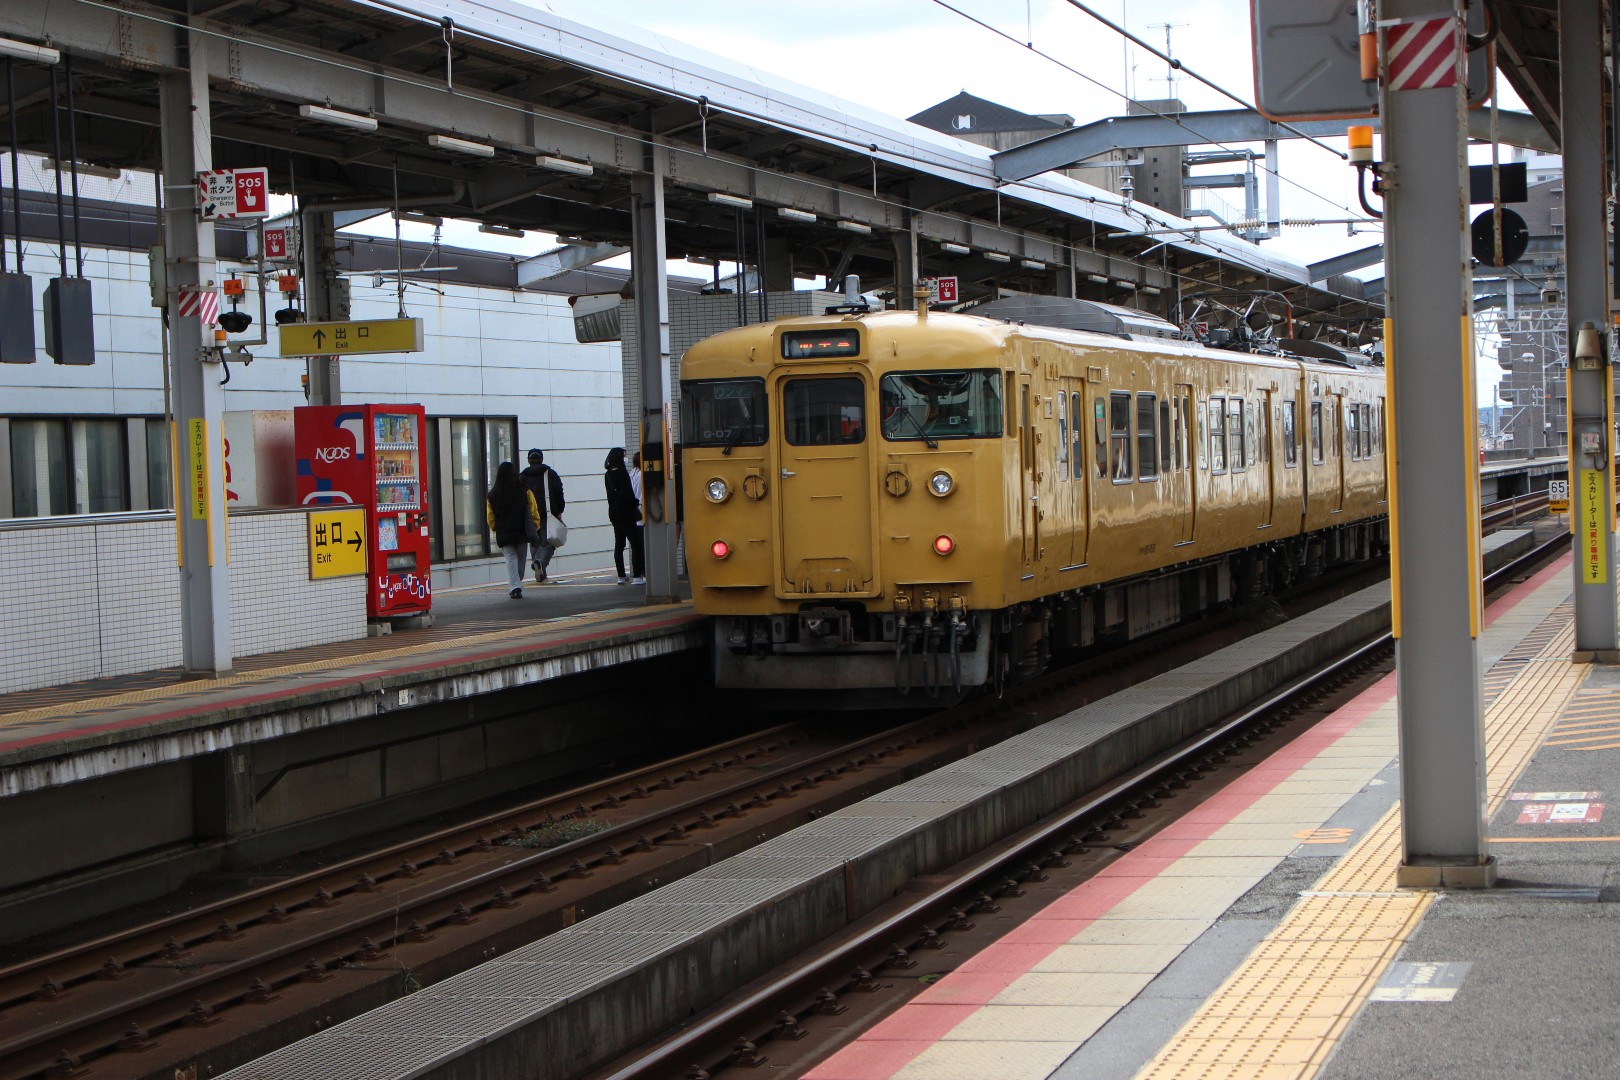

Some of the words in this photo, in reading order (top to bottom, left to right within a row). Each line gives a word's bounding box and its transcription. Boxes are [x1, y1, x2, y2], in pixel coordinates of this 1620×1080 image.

[209, 176, 233, 185] 非常
[238, 178, 261, 188] SOS
[210, 185, 234, 195] ボタン
[267, 233, 283, 241] SOS
[335, 326, 369, 339] 出口
[335, 341, 349, 349] Exit
[715, 387, 753, 397] ワンマン
[703, 430, 732, 438] G-07
[1551, 481, 1565, 493] 65
[315, 521, 342, 547] 出口
[316, 552, 332, 564] Exit
